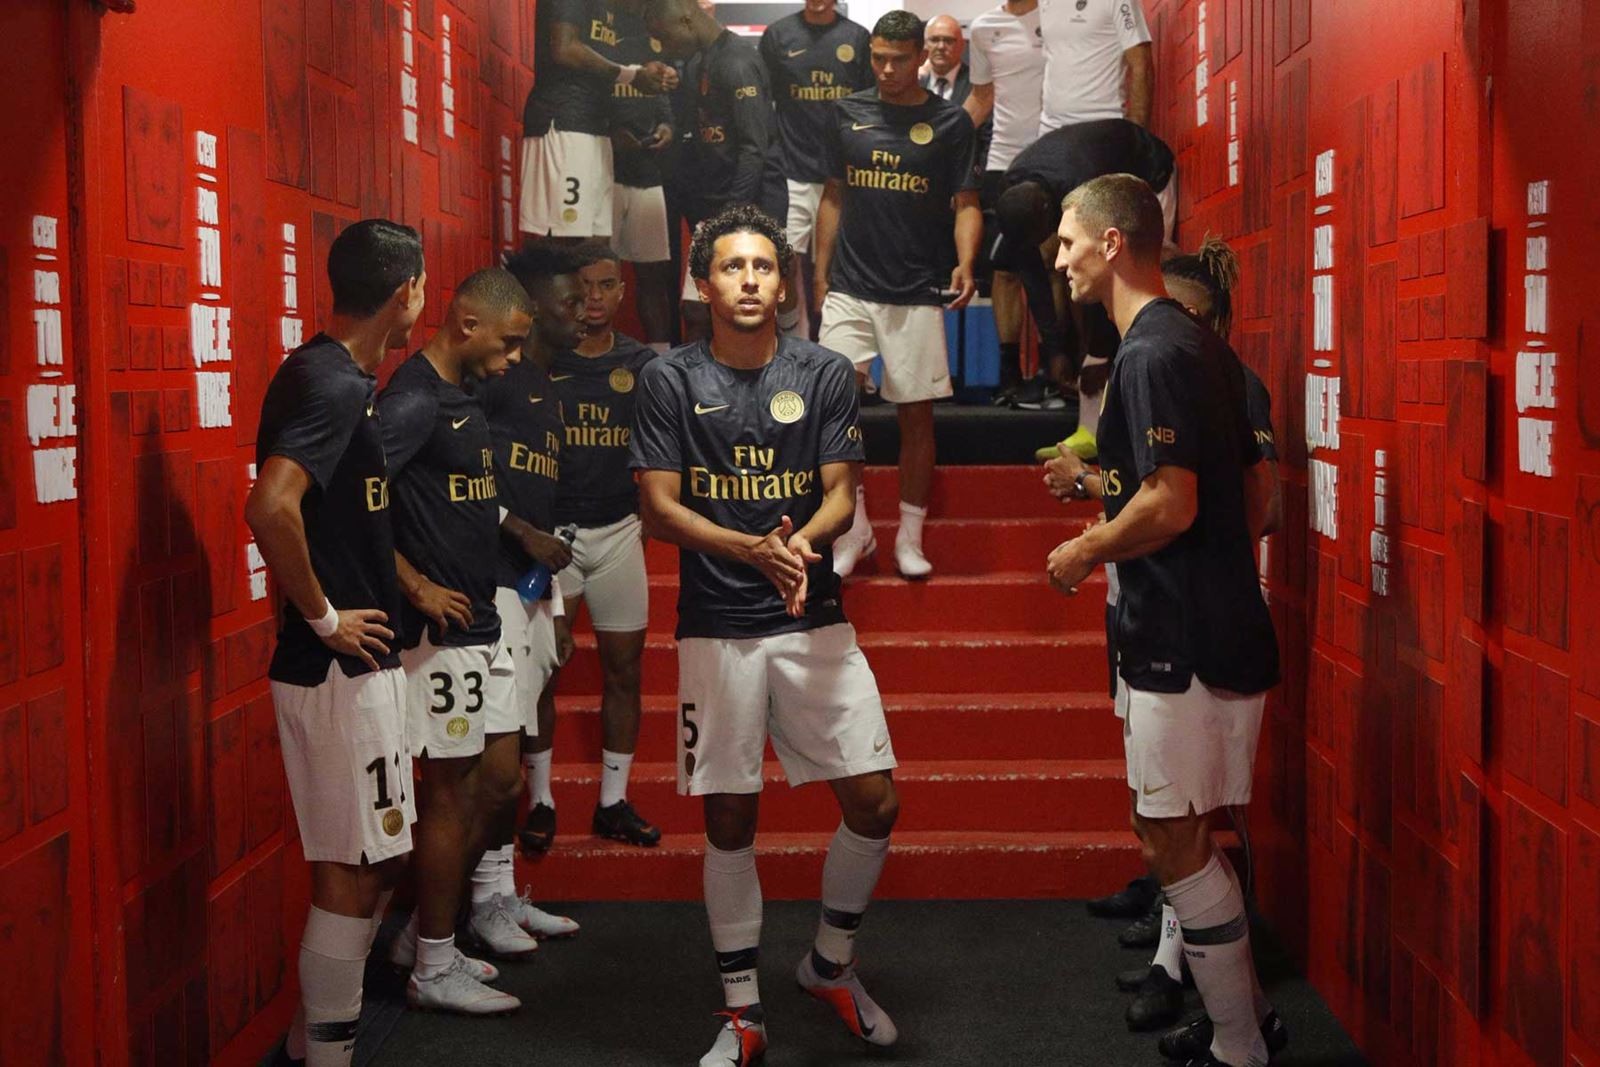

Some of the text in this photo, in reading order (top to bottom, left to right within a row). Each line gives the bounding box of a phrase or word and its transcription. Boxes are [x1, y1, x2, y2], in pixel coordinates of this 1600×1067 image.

[811, 71, 834, 85] Fly
[872, 150, 902, 170] Fly
[564, 177, 581, 205] 3
[847, 166, 930, 193] Emirates
[578, 403, 610, 424] Fly
[733, 445, 775, 471] Fly
[430, 671, 484, 714] 33
[682, 703, 699, 749] 5
[724, 974, 751, 985] PARIS
